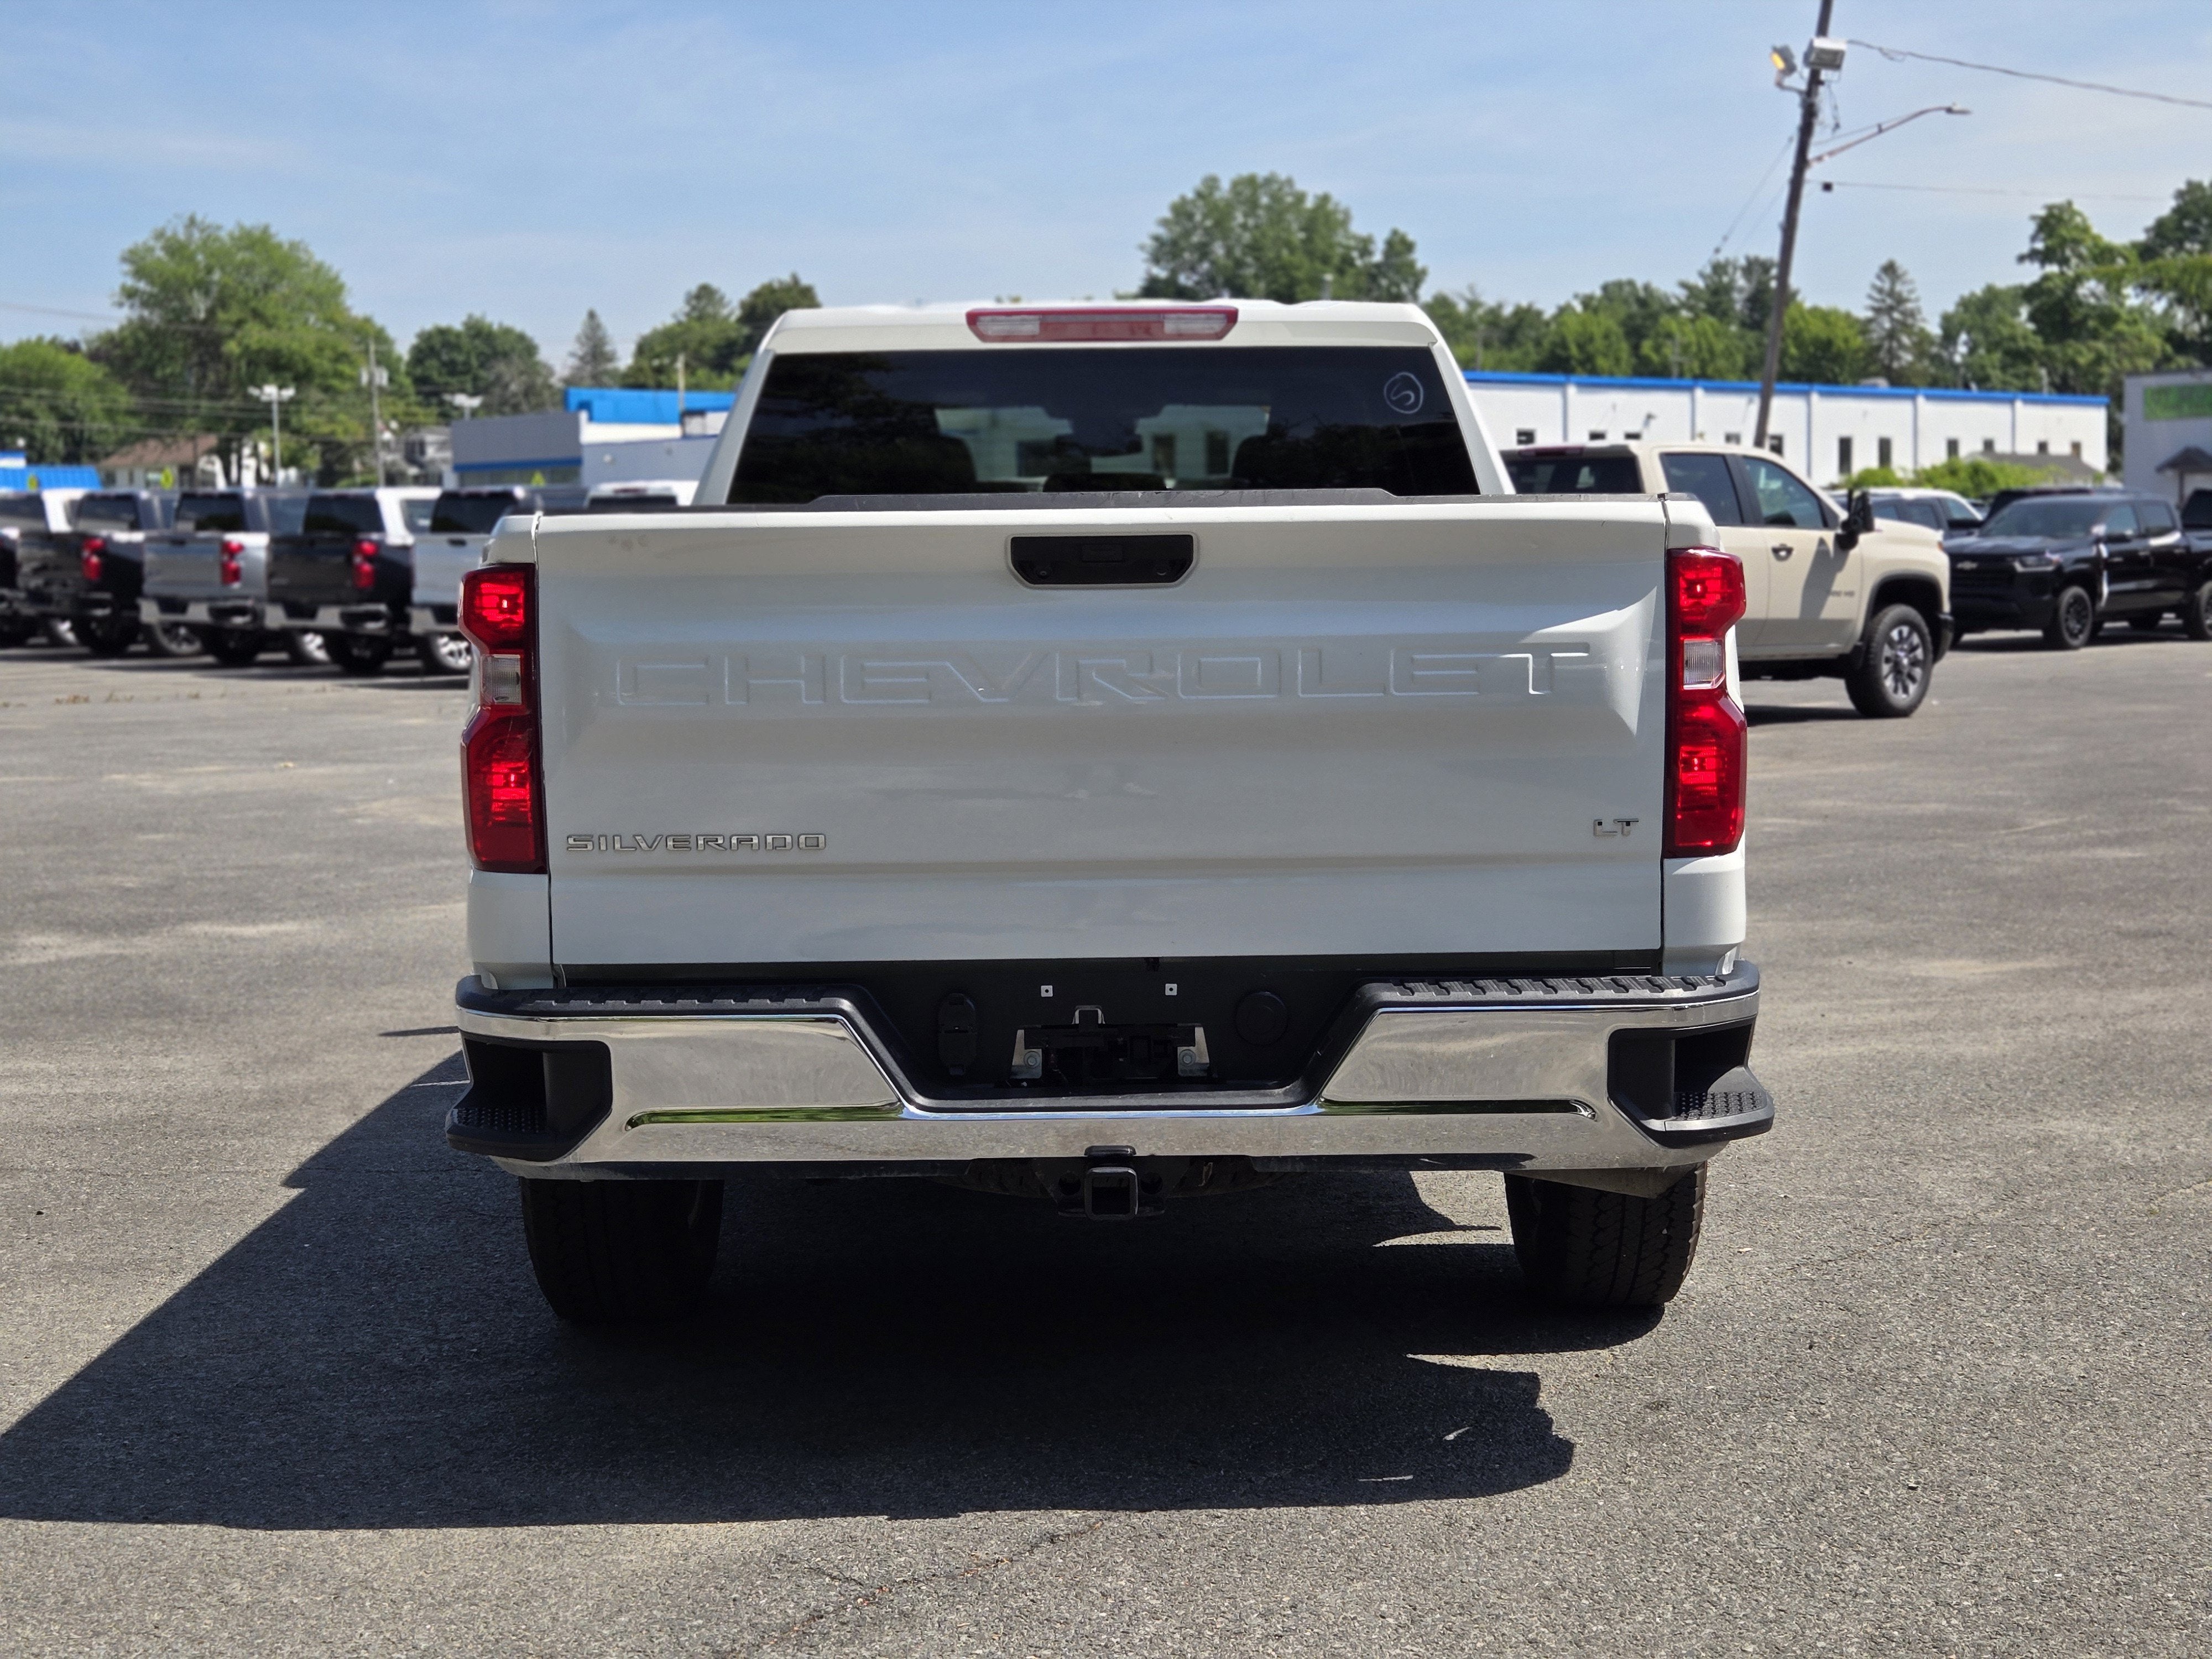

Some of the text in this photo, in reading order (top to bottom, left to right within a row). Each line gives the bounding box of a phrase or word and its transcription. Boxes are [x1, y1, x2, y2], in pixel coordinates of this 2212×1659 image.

[615, 641, 1591, 707] CHEVROLET
[1593, 818, 1639, 837] LT
[566, 833, 827, 852] SILVERADO
